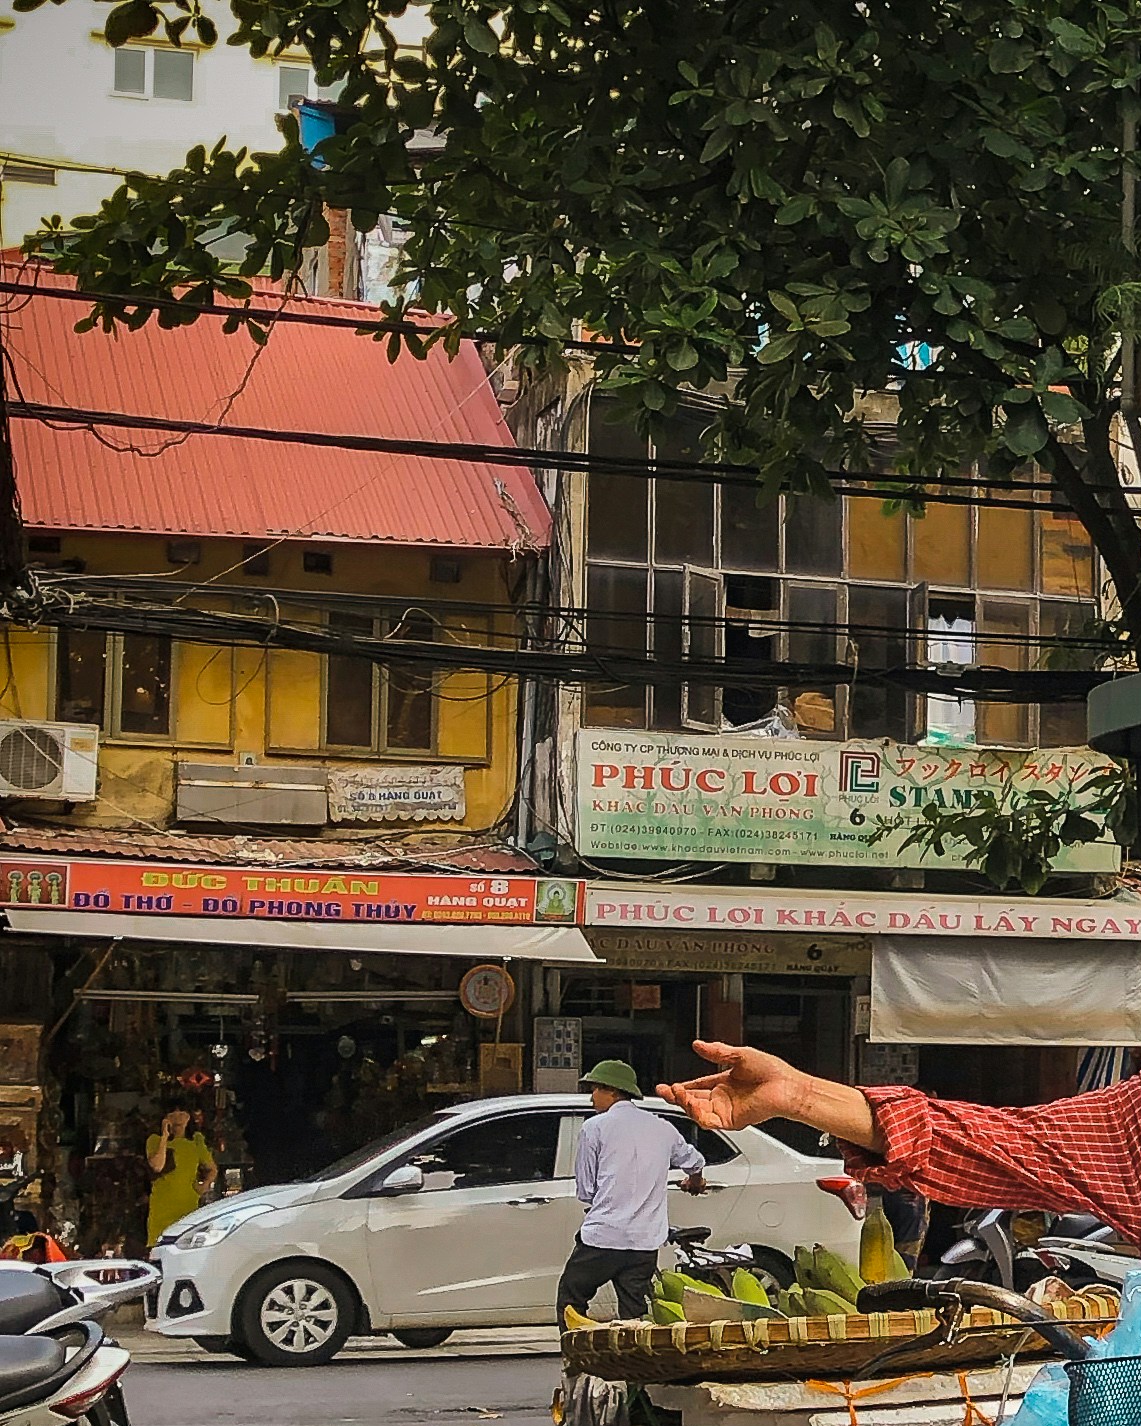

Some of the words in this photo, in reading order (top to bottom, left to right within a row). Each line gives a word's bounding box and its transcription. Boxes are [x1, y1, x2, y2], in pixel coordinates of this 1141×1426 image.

[591, 740, 621, 752] CÔNG
[624, 743, 637, 753] TY
[640, 744, 654, 754] CP
[656, 745, 699, 756] THƯƠNG
[702, 747, 720, 759] MẠI
[722, 748, 729, 757] &
[731, 749, 755, 760] DỊCH
[757, 750, 772, 762] VỤ
[774, 750, 802, 761] PHÚC
[804, 751, 820, 763] LỢI
[591, 760, 726, 793] PHÚC
[741, 770, 818, 802] LỢI
[849, 807, 866, 826] 6
[830, 832, 856, 841] HÀNG
[141, 871, 227, 890] ĐỨC
[489, 879, 509, 895] 8
[248, 899, 342, 918] PHONG
[427, 895, 478, 907] HÀNG
[482, 897, 528, 909] QUẠT
[596, 900, 695, 922] PHÚC
[707, 906, 764, 928] LỢI
[887, 906, 962, 930] DẤU
[974, 908, 1040, 932] LẤY
[806, 943, 823, 961] 6
